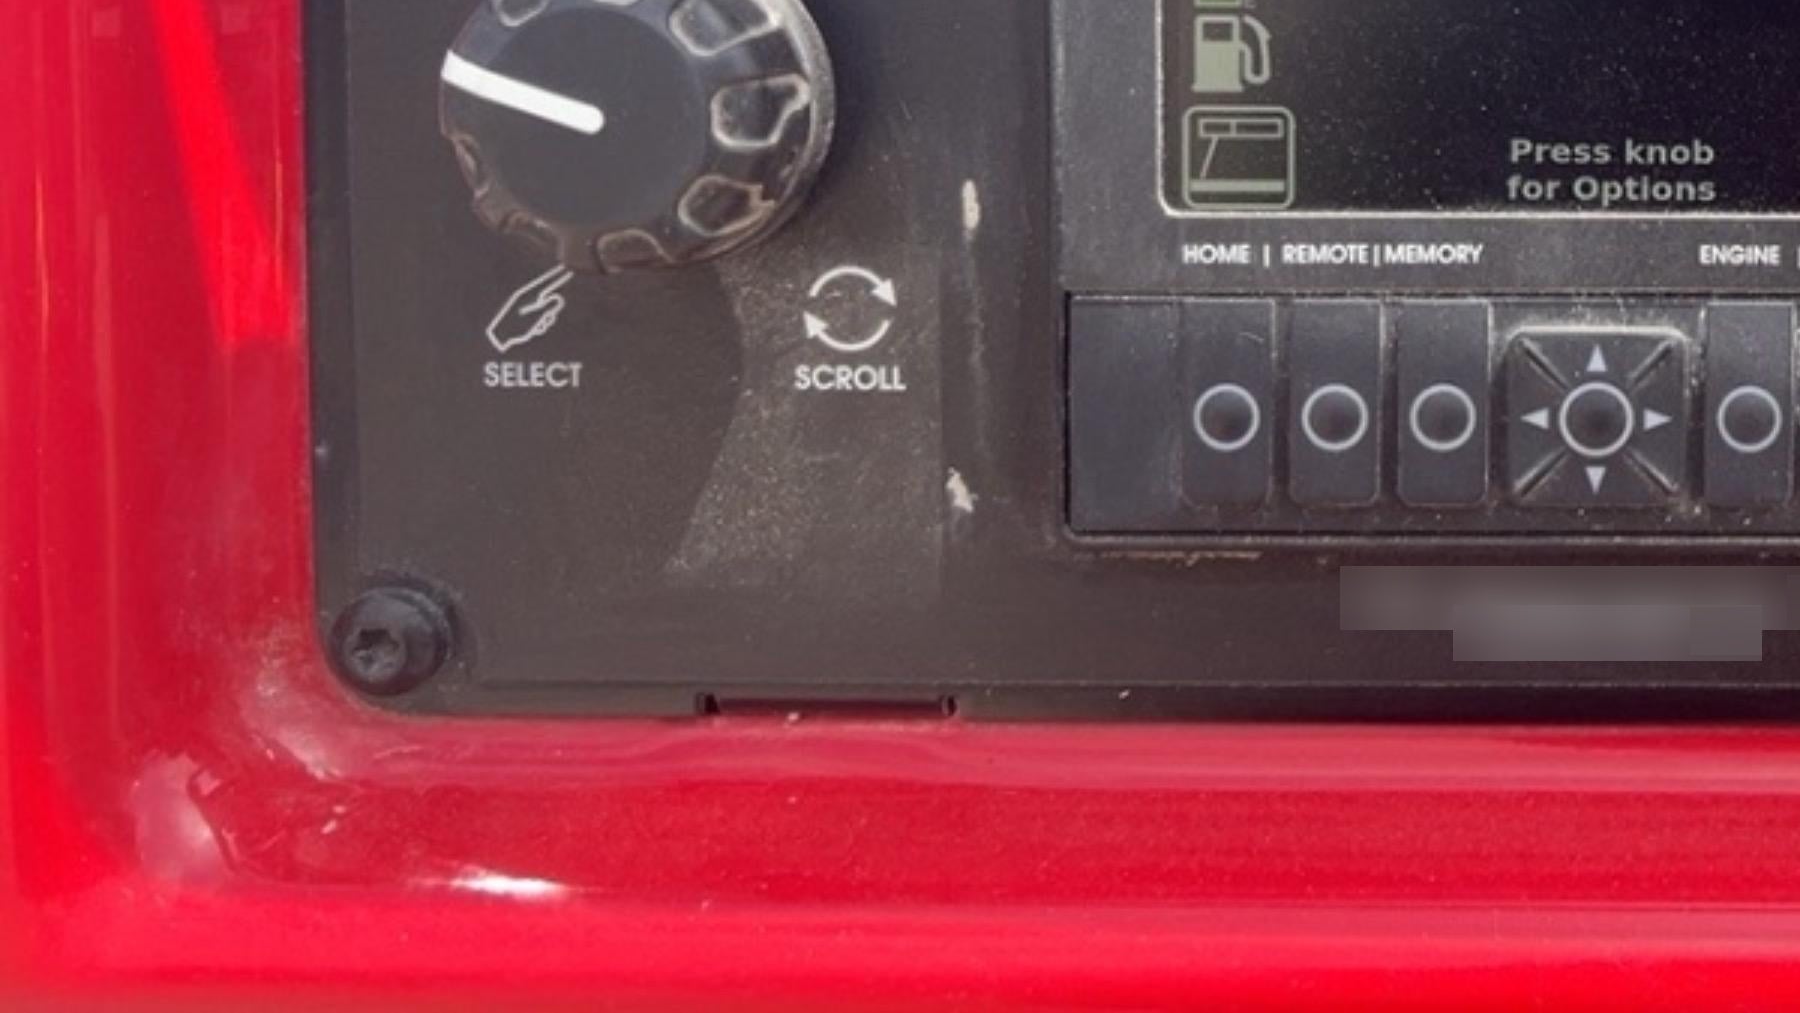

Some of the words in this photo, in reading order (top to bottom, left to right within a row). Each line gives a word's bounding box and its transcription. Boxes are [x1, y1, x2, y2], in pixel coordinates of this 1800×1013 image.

[1510, 138, 1612, 165] Press
[1624, 137, 1715, 165] knob
[1505, 174, 1561, 201] for
[1573, 174, 1717, 208] Options
[1182, 243, 1250, 265] HOME
[1282, 243, 1370, 265] REMOTE
[1384, 243, 1484, 265] MEMORY
[1699, 244, 1782, 266] ENGINE
[483, 361, 583, 388] SELECT
[794, 363, 907, 391] SCROLL
